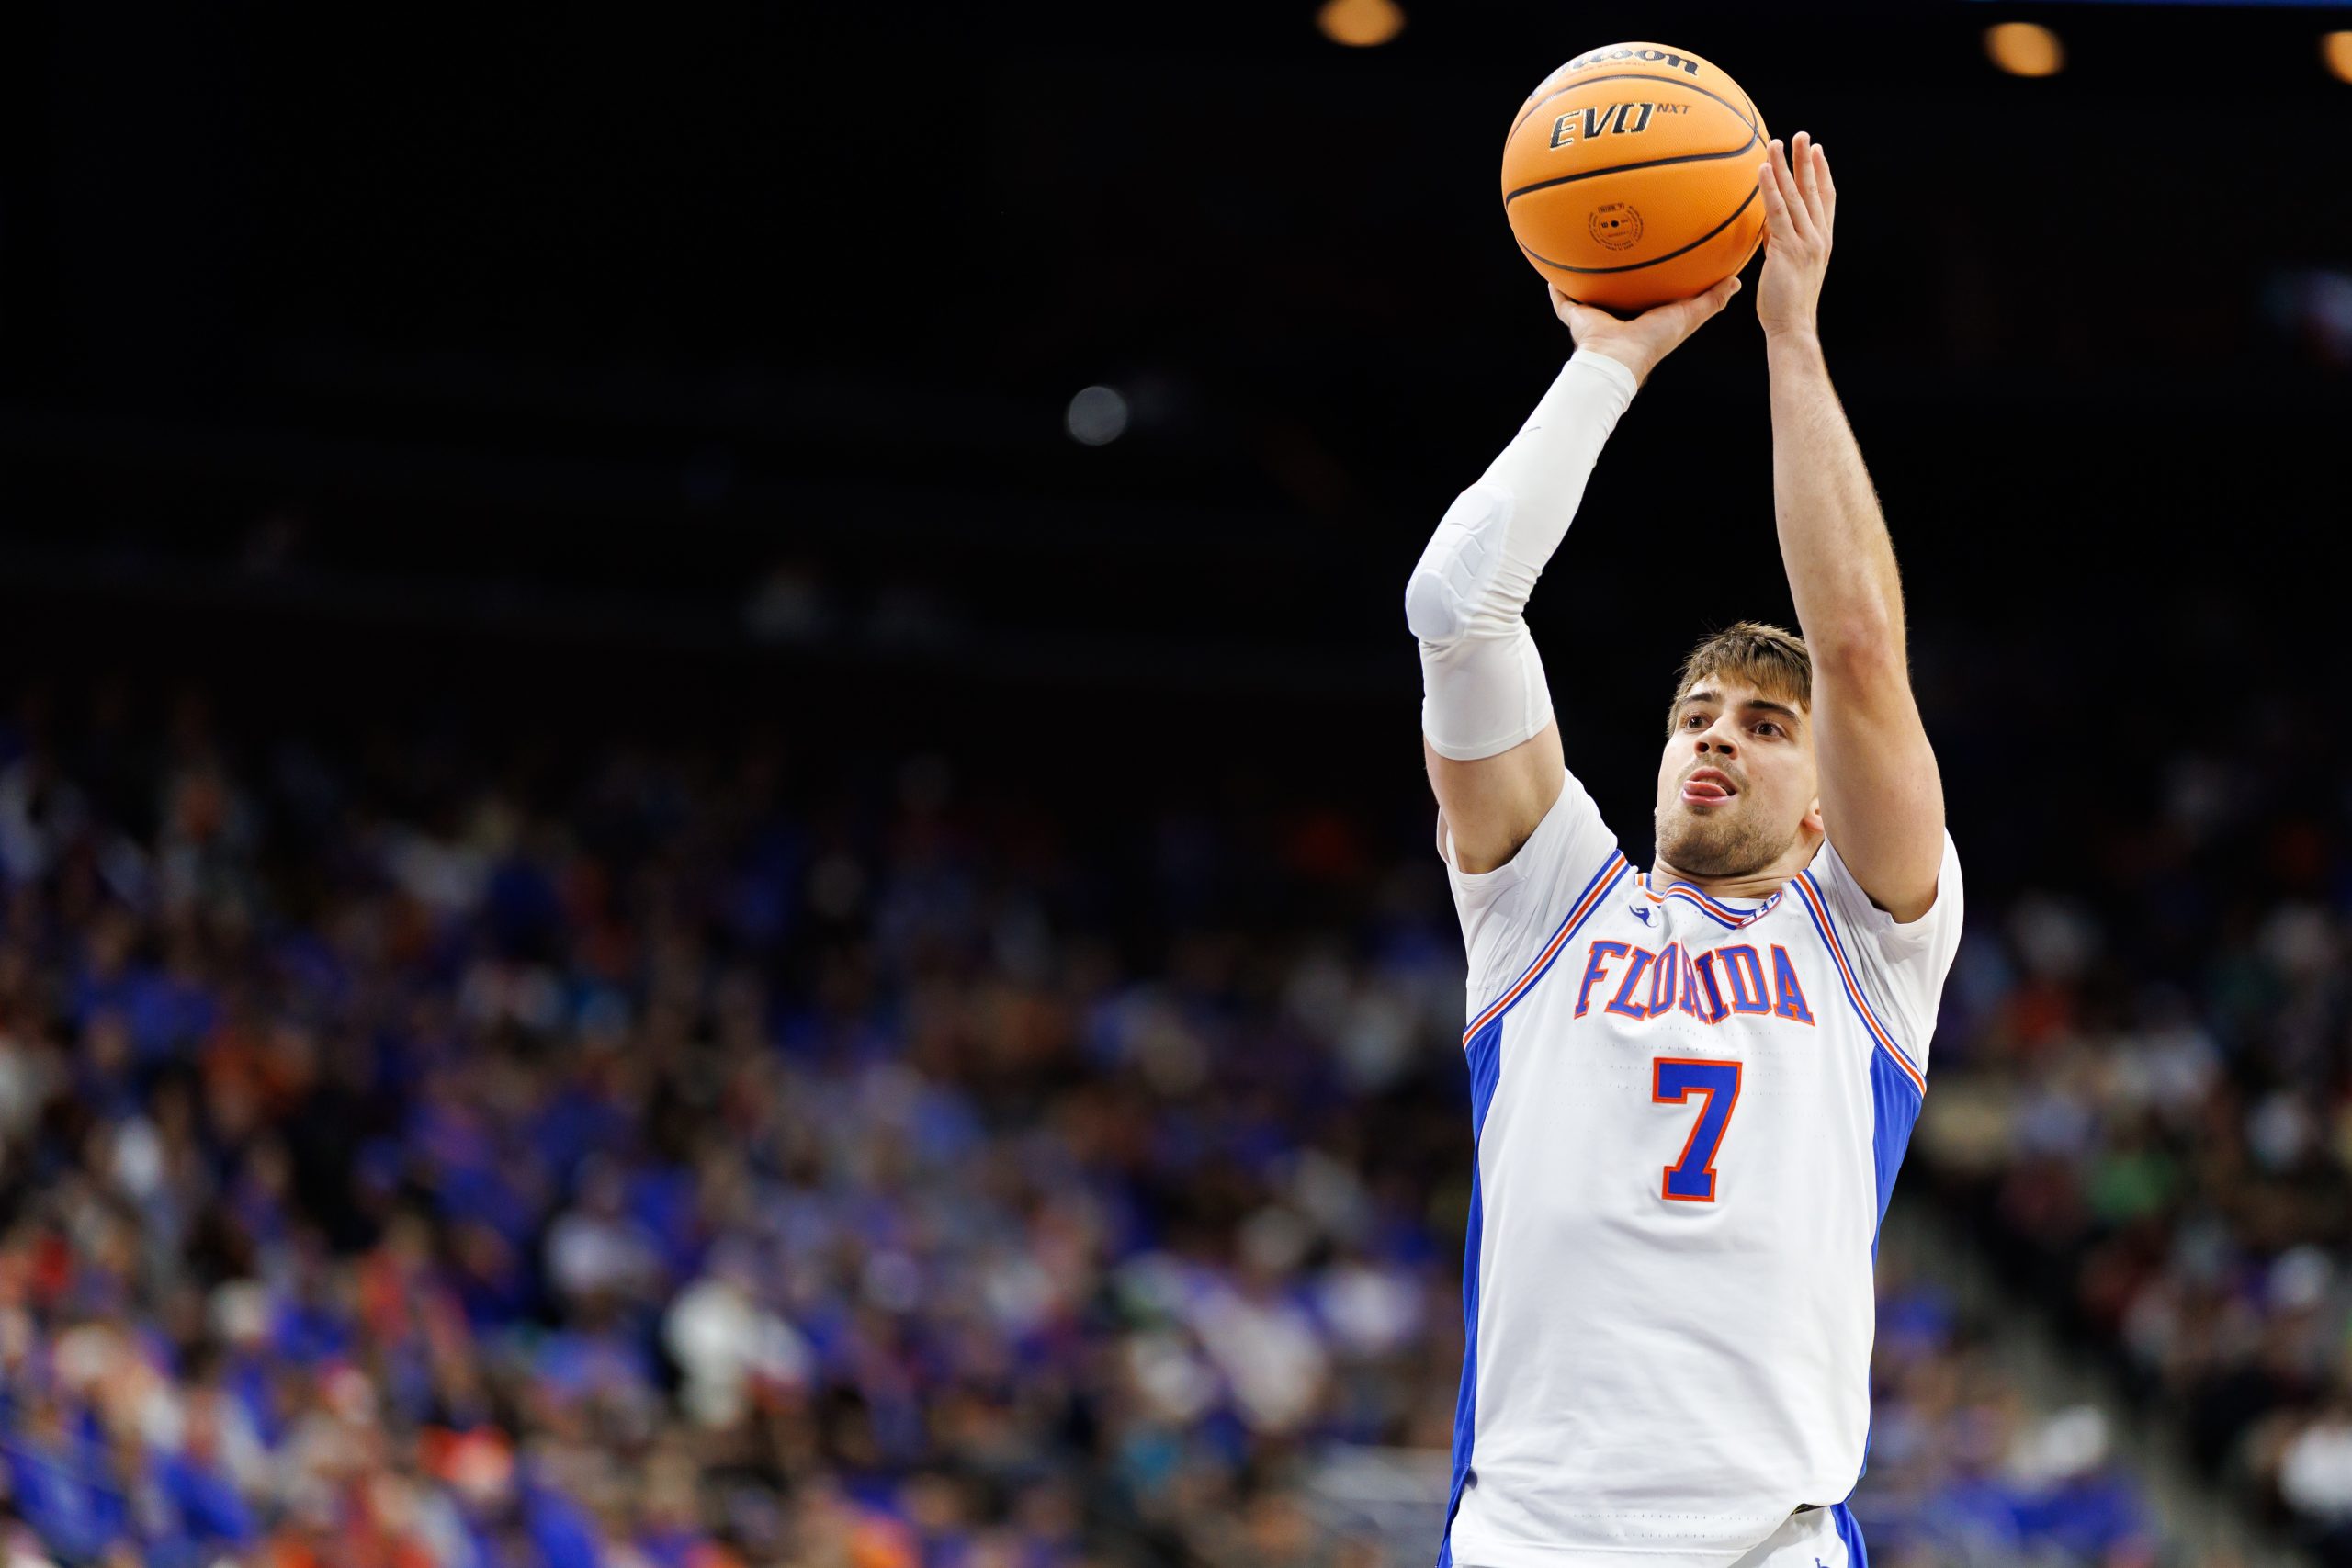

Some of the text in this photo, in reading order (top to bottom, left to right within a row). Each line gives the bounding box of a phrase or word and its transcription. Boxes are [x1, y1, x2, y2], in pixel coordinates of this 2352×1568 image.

[1549, 102, 1692, 151] EVO NXT
[1574, 938, 1816, 1028] FLORIDA
[1652, 1056, 1743, 1203] 7
